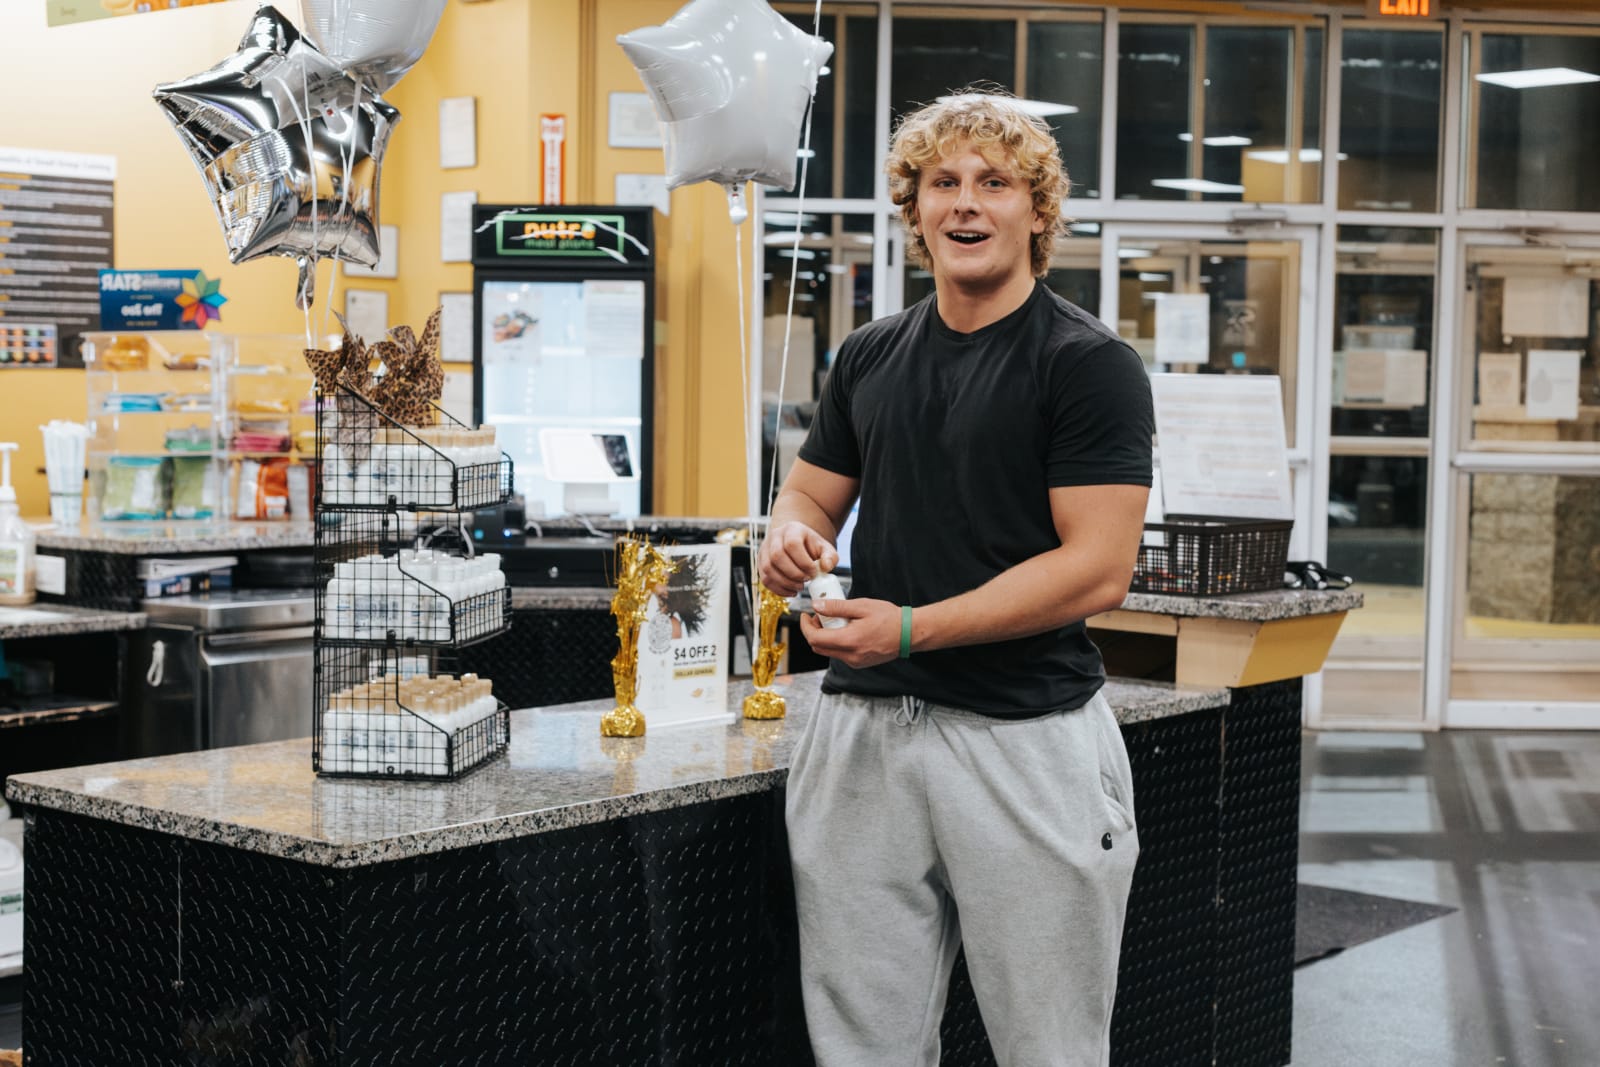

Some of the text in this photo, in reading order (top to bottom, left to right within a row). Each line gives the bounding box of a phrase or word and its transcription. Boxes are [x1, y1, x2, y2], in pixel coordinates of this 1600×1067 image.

[674, 647, 686, 660] $4
[689, 645, 709, 658] OFF
[711, 645, 717, 656] 2
